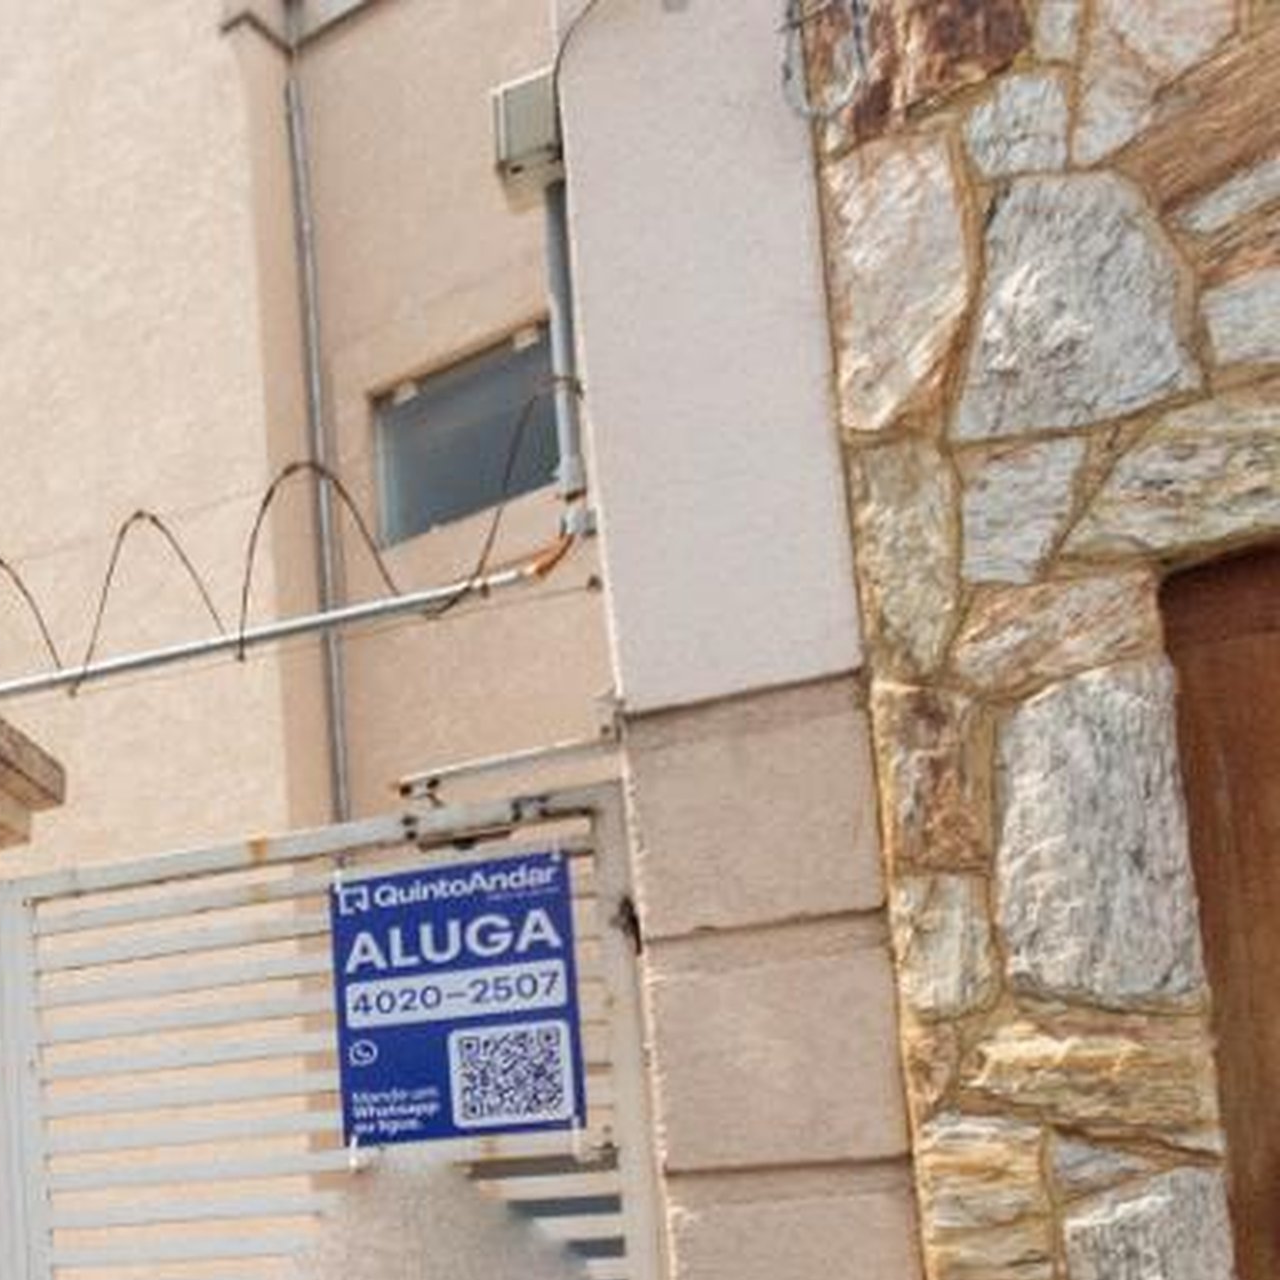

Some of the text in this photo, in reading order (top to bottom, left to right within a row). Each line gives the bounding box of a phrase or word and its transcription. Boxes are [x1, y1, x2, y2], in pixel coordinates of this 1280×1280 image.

[374, 865, 557, 906] QuintoAndar
[346, 910, 562, 973] ALUGA
[352, 972, 559, 1014] 4020-2507
